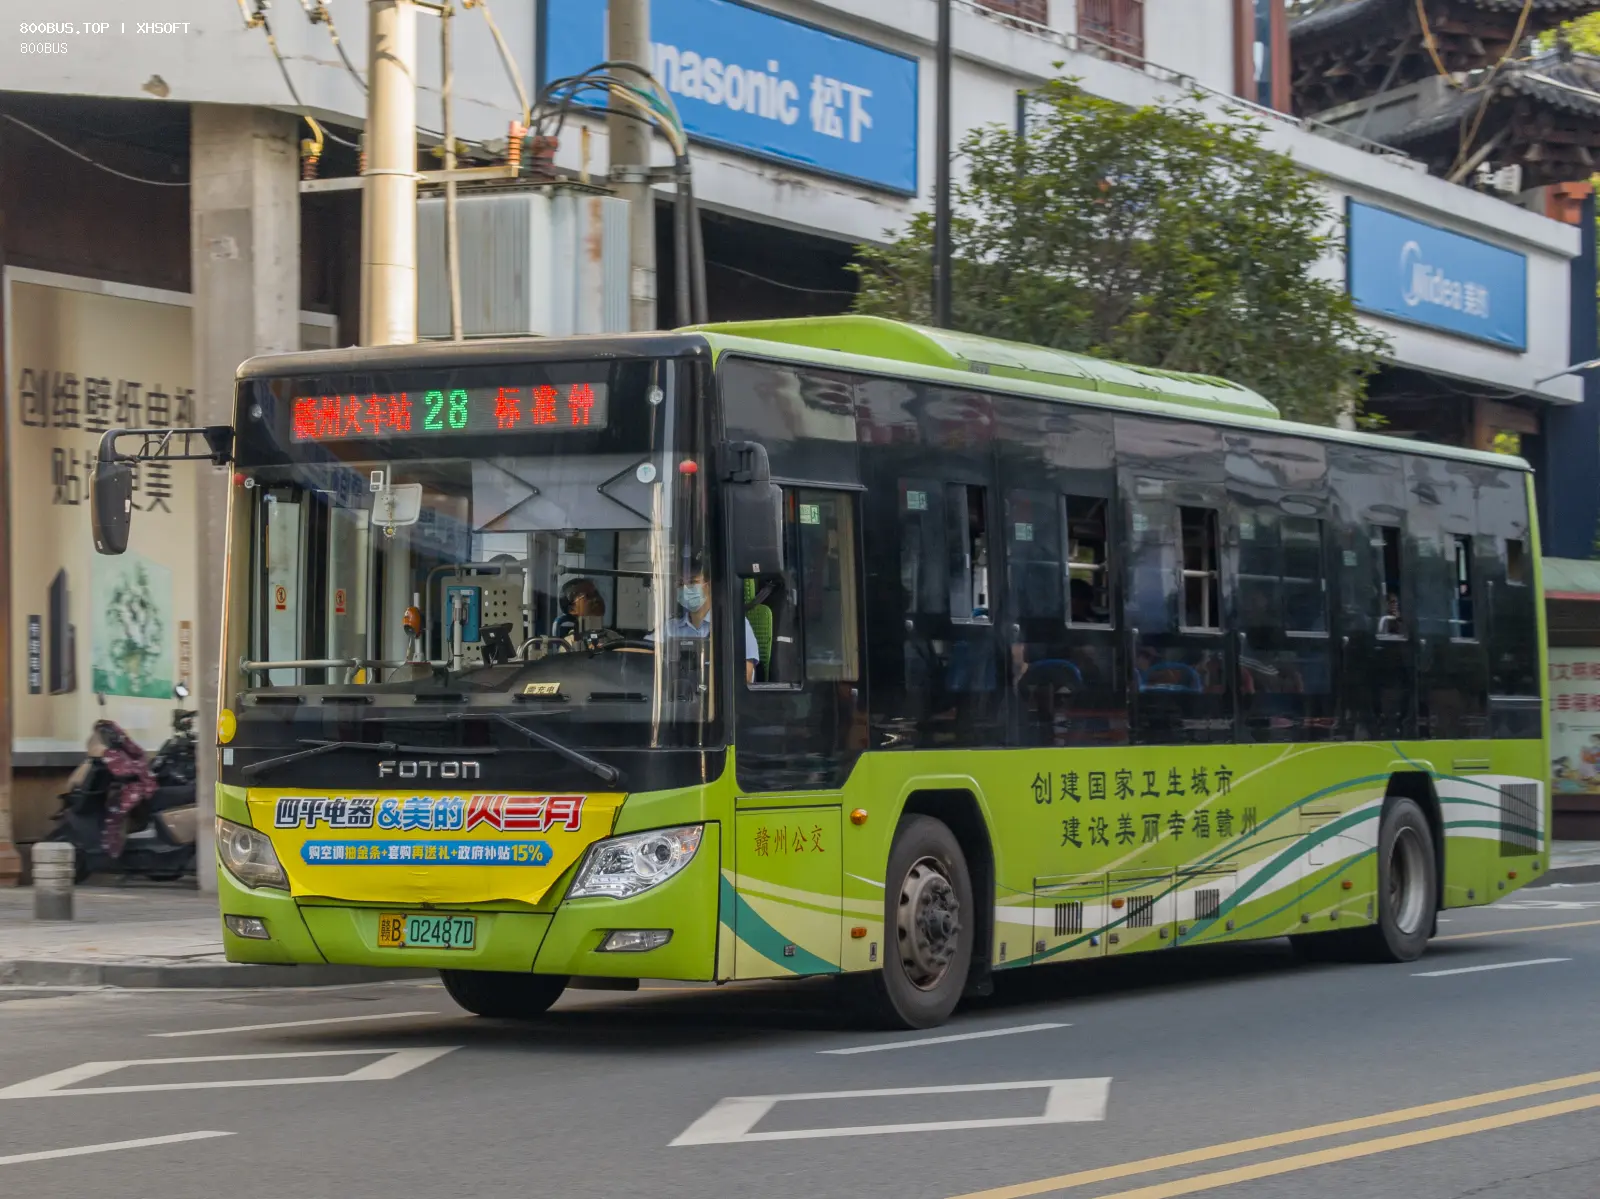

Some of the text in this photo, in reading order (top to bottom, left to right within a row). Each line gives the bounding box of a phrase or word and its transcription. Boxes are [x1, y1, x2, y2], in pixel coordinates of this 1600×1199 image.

[650, 41, 799, 125] nasonic
[809, 74, 873, 143] 松下
[293, 392, 413, 439] 赣州火车站
[424, 389, 468, 430] 28
[378, 760, 480, 778] FOTON
[1031, 765, 1234, 804] 创建国家卫生城市
[754, 824, 825, 857] 赣州公交
[1061, 807, 1258, 848] 建设美丽幸福赣州
